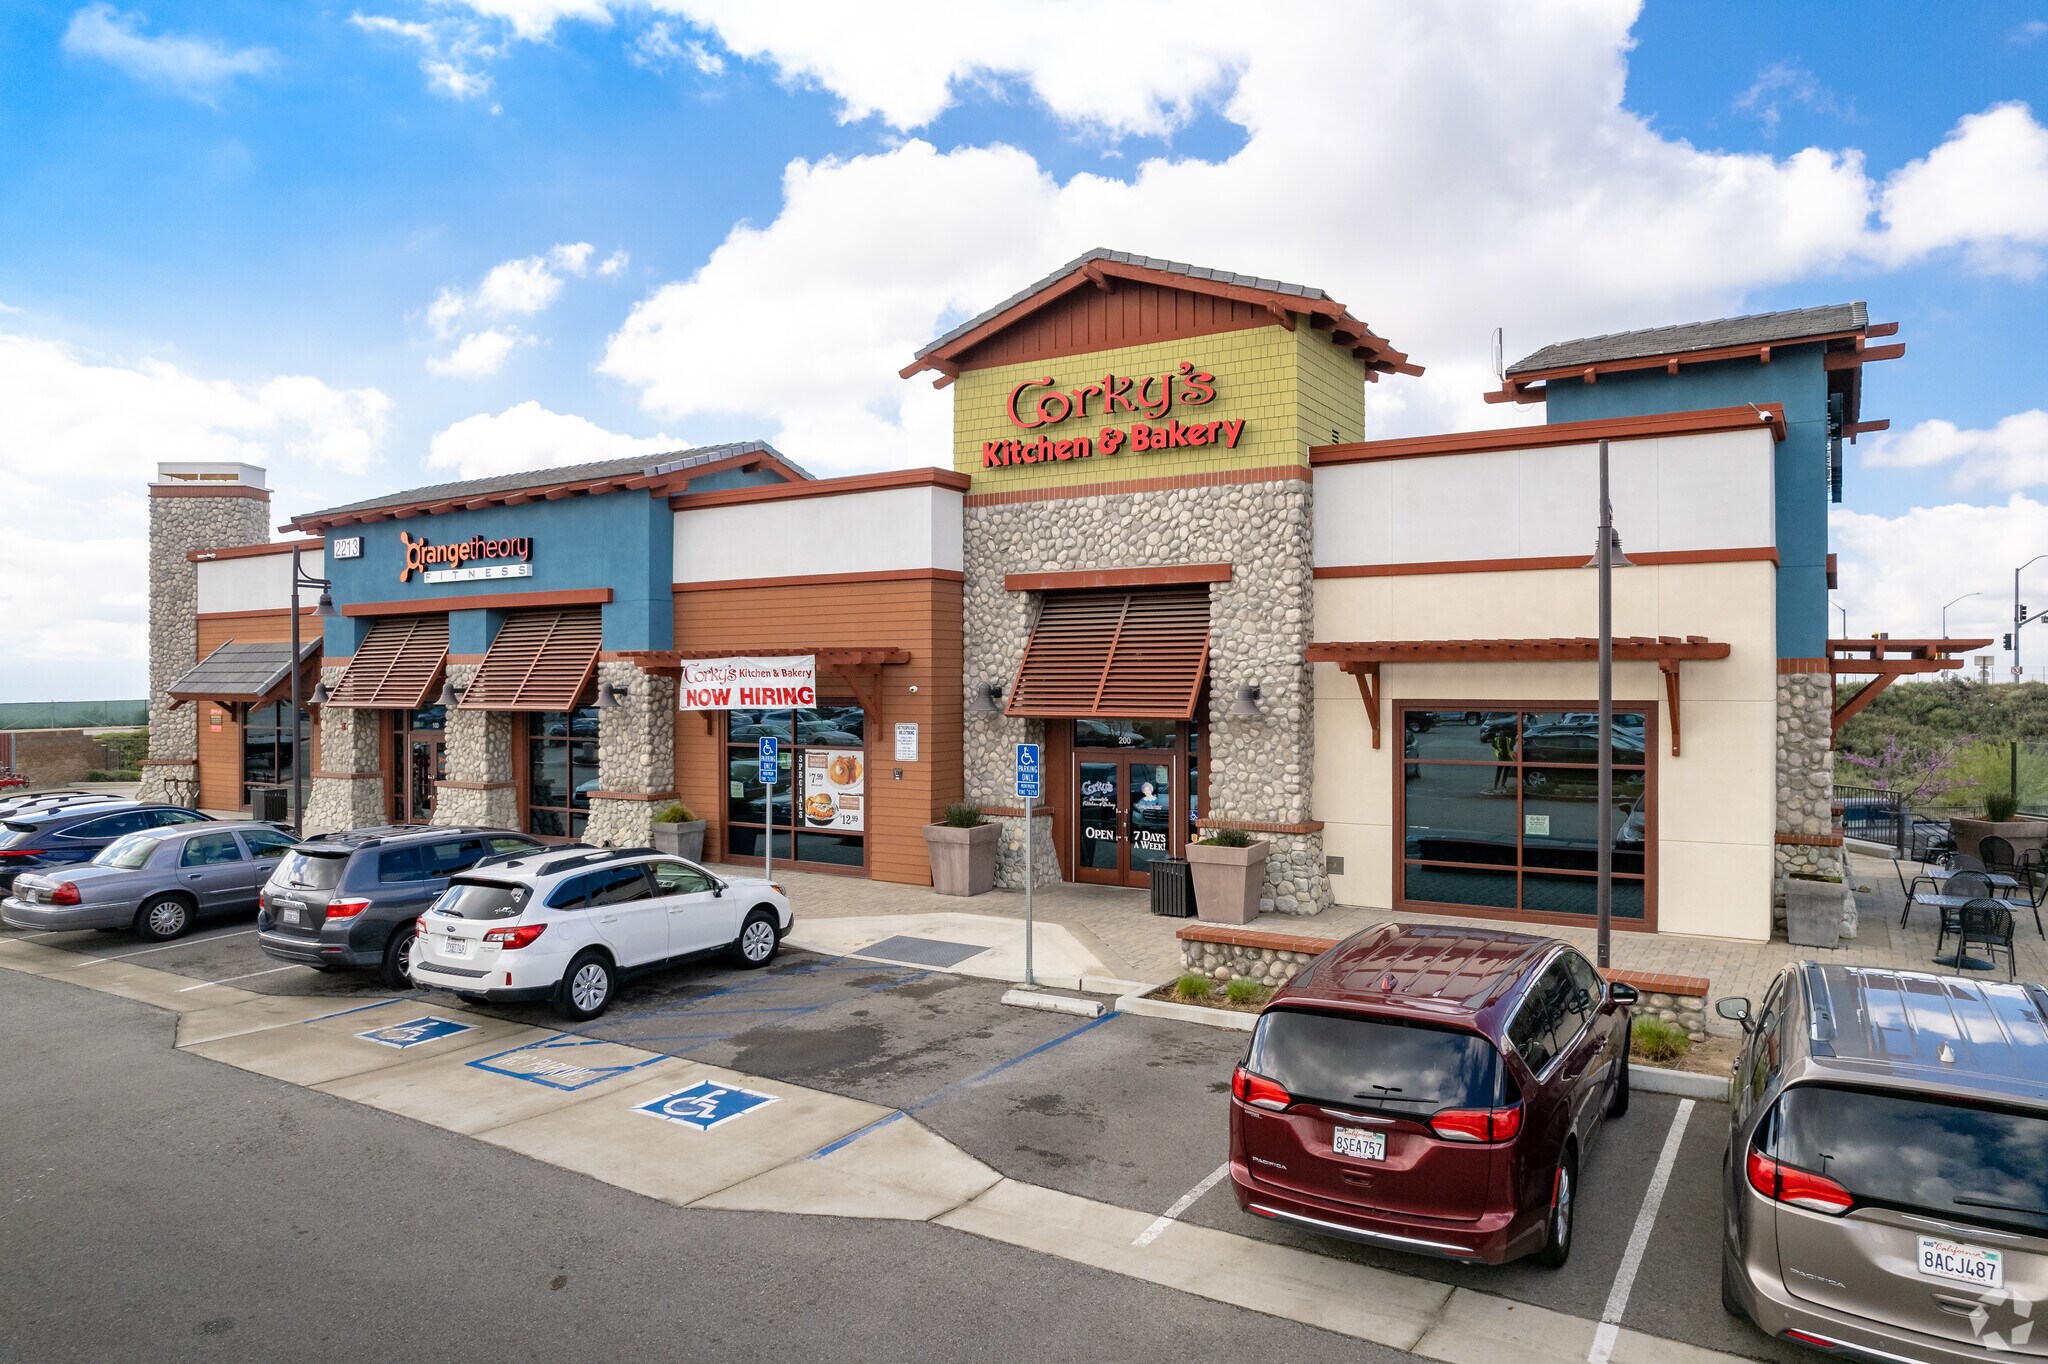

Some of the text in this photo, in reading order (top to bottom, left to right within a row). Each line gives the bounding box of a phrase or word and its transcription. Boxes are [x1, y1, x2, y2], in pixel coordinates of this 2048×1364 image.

[1007, 361, 1215, 428] Corky's
[983, 419, 1245, 468] Kitchen & Bakery
[335, 539, 359, 557] 2213
[425, 565, 526, 582] FITNESS
[684, 663, 812, 685] Corky's Kitchen & Bakery
[686, 686, 814, 707] NOW HIRING
[1118, 736, 1131, 745] 200
[1018, 765, 1038, 773] PARKING
[809, 772, 824, 784] $7.99
[1021, 773, 1034, 781] ONLY
[1082, 780, 1114, 795] Corky's
[840, 813, 859, 825] $12.99
[1085, 826, 1114, 840] OPEN
[1133, 830, 1166, 842] 7 DAYS
[1133, 841, 1166, 851] A WEEK!
[1336, 1136, 1382, 1156] 8SEA757
[1935, 1241, 1983, 1257] California
[1925, 1251, 1996, 1281] 8ACJ487
